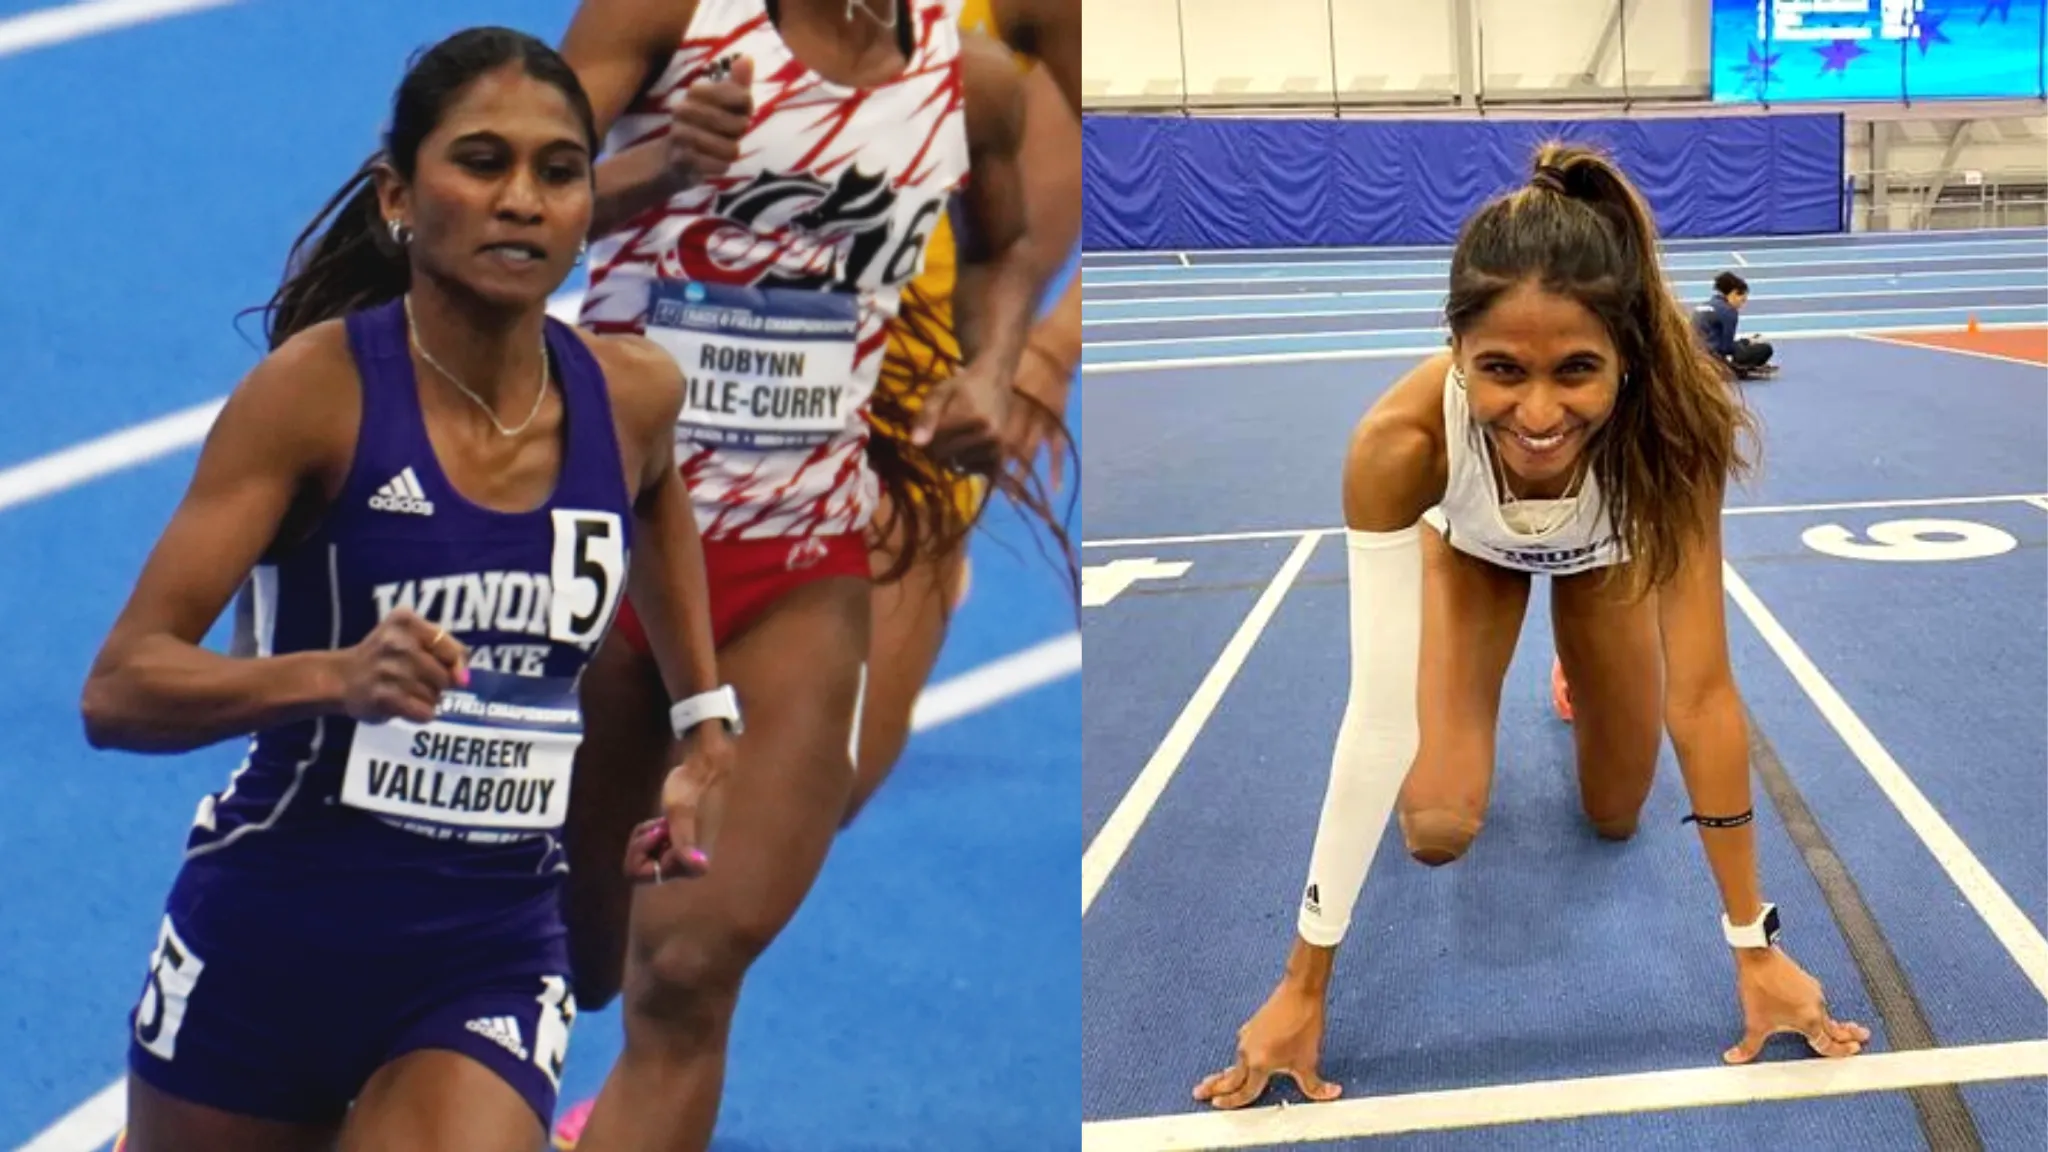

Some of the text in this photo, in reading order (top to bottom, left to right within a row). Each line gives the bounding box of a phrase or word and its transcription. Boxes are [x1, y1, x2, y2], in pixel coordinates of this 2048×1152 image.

[882, 199, 941, 284] 6
[700, 343, 805, 378] ROBYNN
[683, 377, 842, 419] LLE-CURRY
[367, 493, 434, 516] adidas
[569, 518, 609, 637] 5
[372, 570, 554, 636] WINON
[467, 644, 552, 678] ATE
[410, 730, 535, 769] SHEREEN
[367, 758, 556, 816] VALLABOUY
